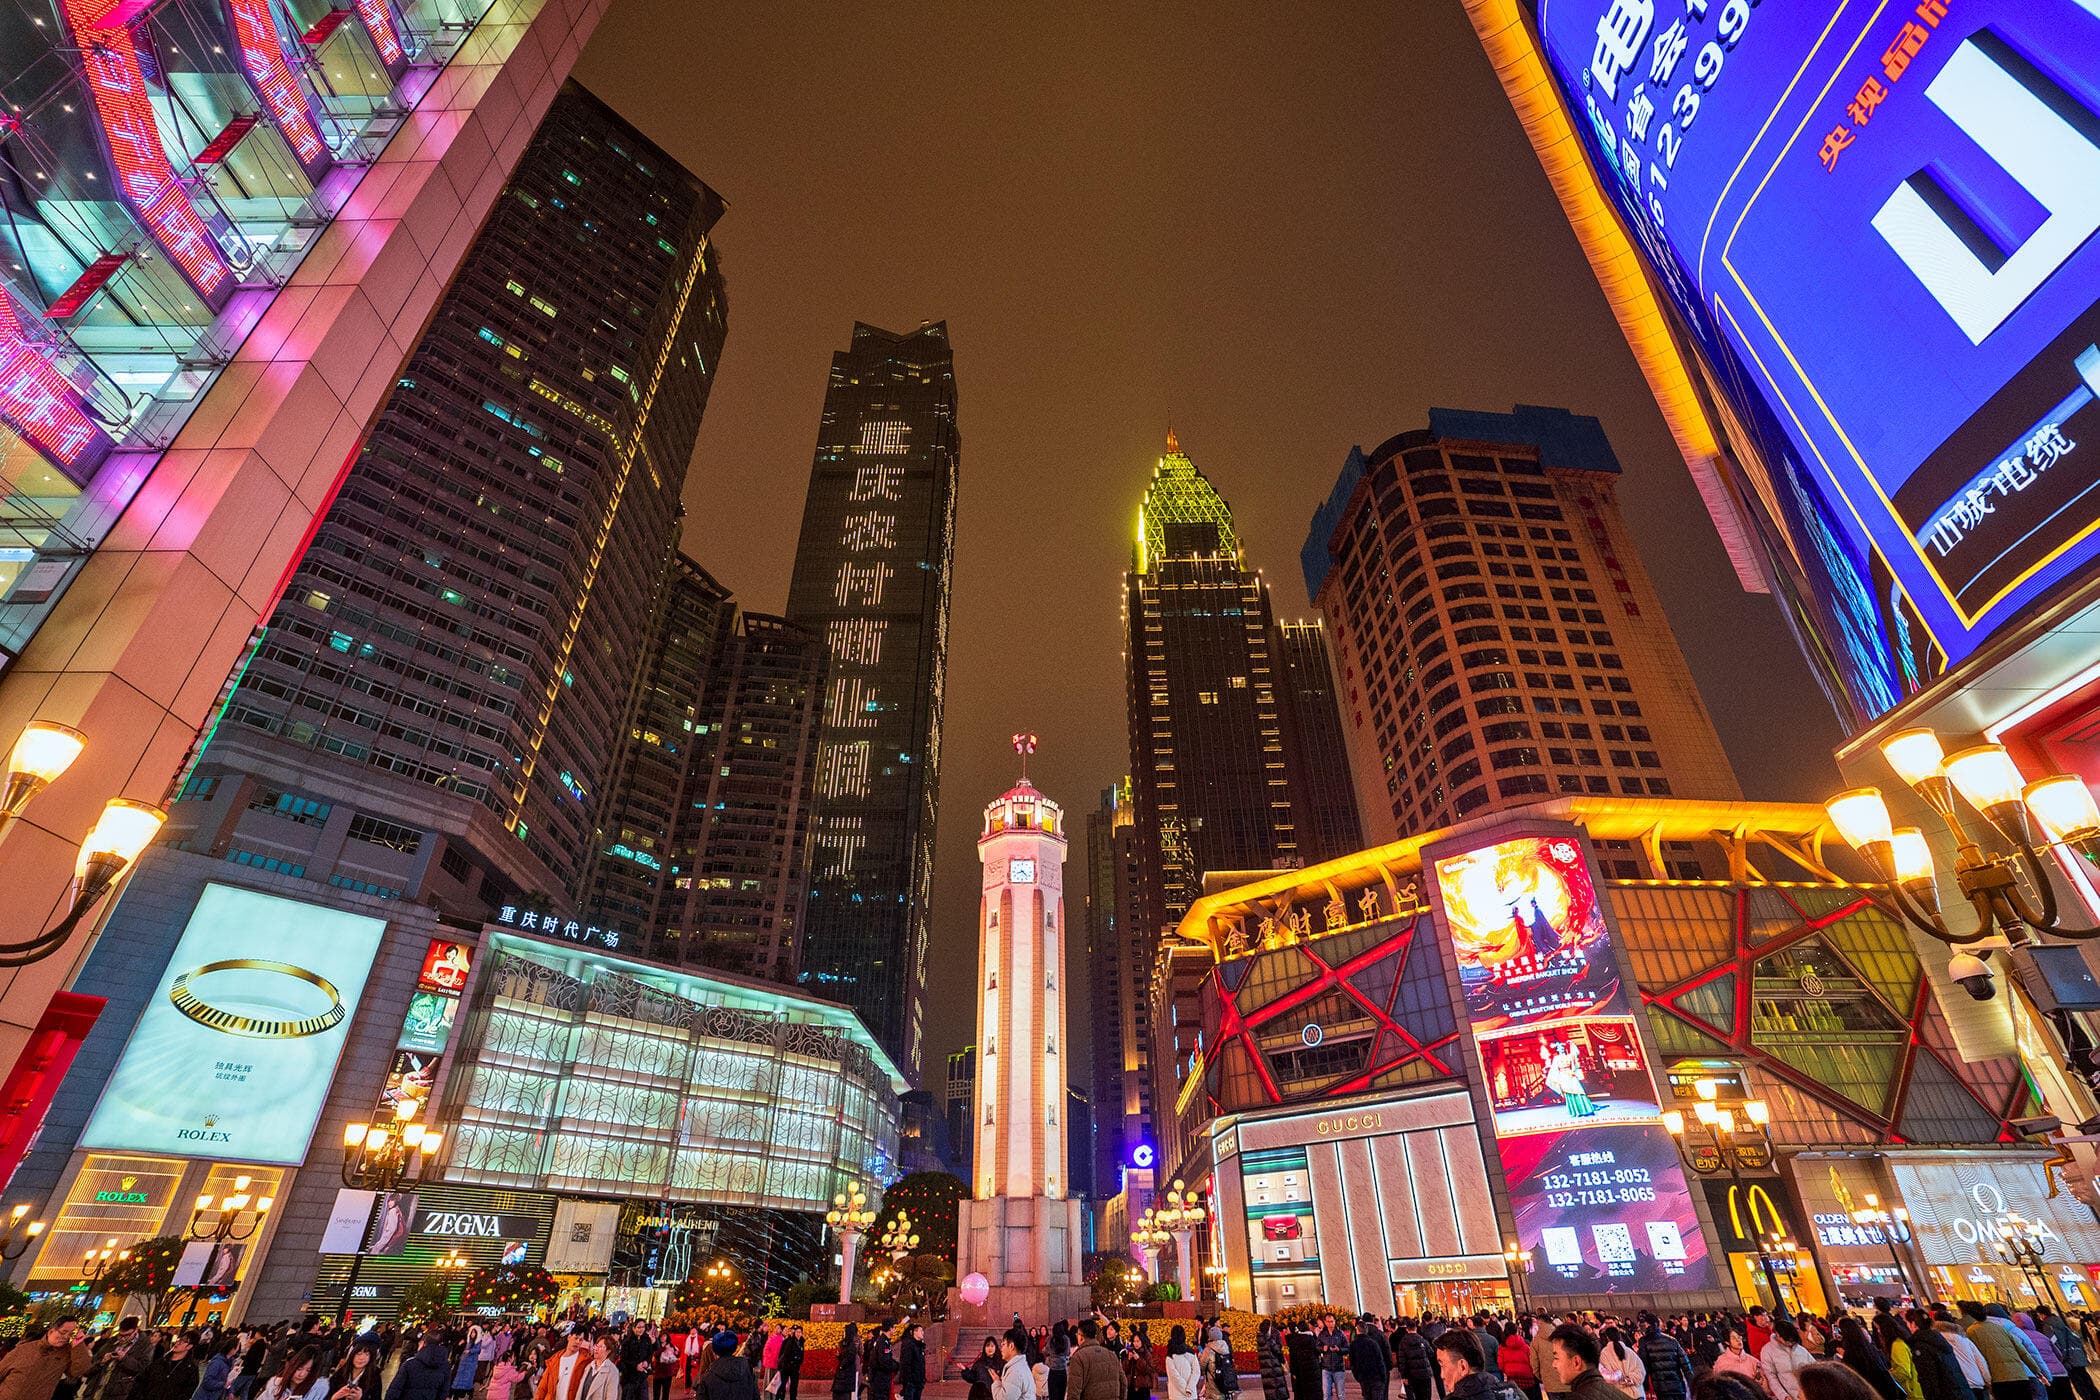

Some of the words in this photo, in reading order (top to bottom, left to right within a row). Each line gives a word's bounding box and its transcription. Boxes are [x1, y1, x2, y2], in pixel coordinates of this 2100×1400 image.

[1930, 422, 2077, 558] 山城电缆
[498, 905, 620, 948] 重庆时代广场
[1317, 1112, 1382, 1135] GUCCI
[177, 1128, 232, 1143] ROLEX
[1542, 1168, 1651, 1190] 132-7181-8052
[95, 1191, 149, 1203] ROLEX
[1547, 1187, 1656, 1208] 132-7181-8065
[423, 1211, 502, 1238] ZEGNA
[1428, 1263, 1467, 1275] GUCCI
[341, 1286, 378, 1298] EGNA
